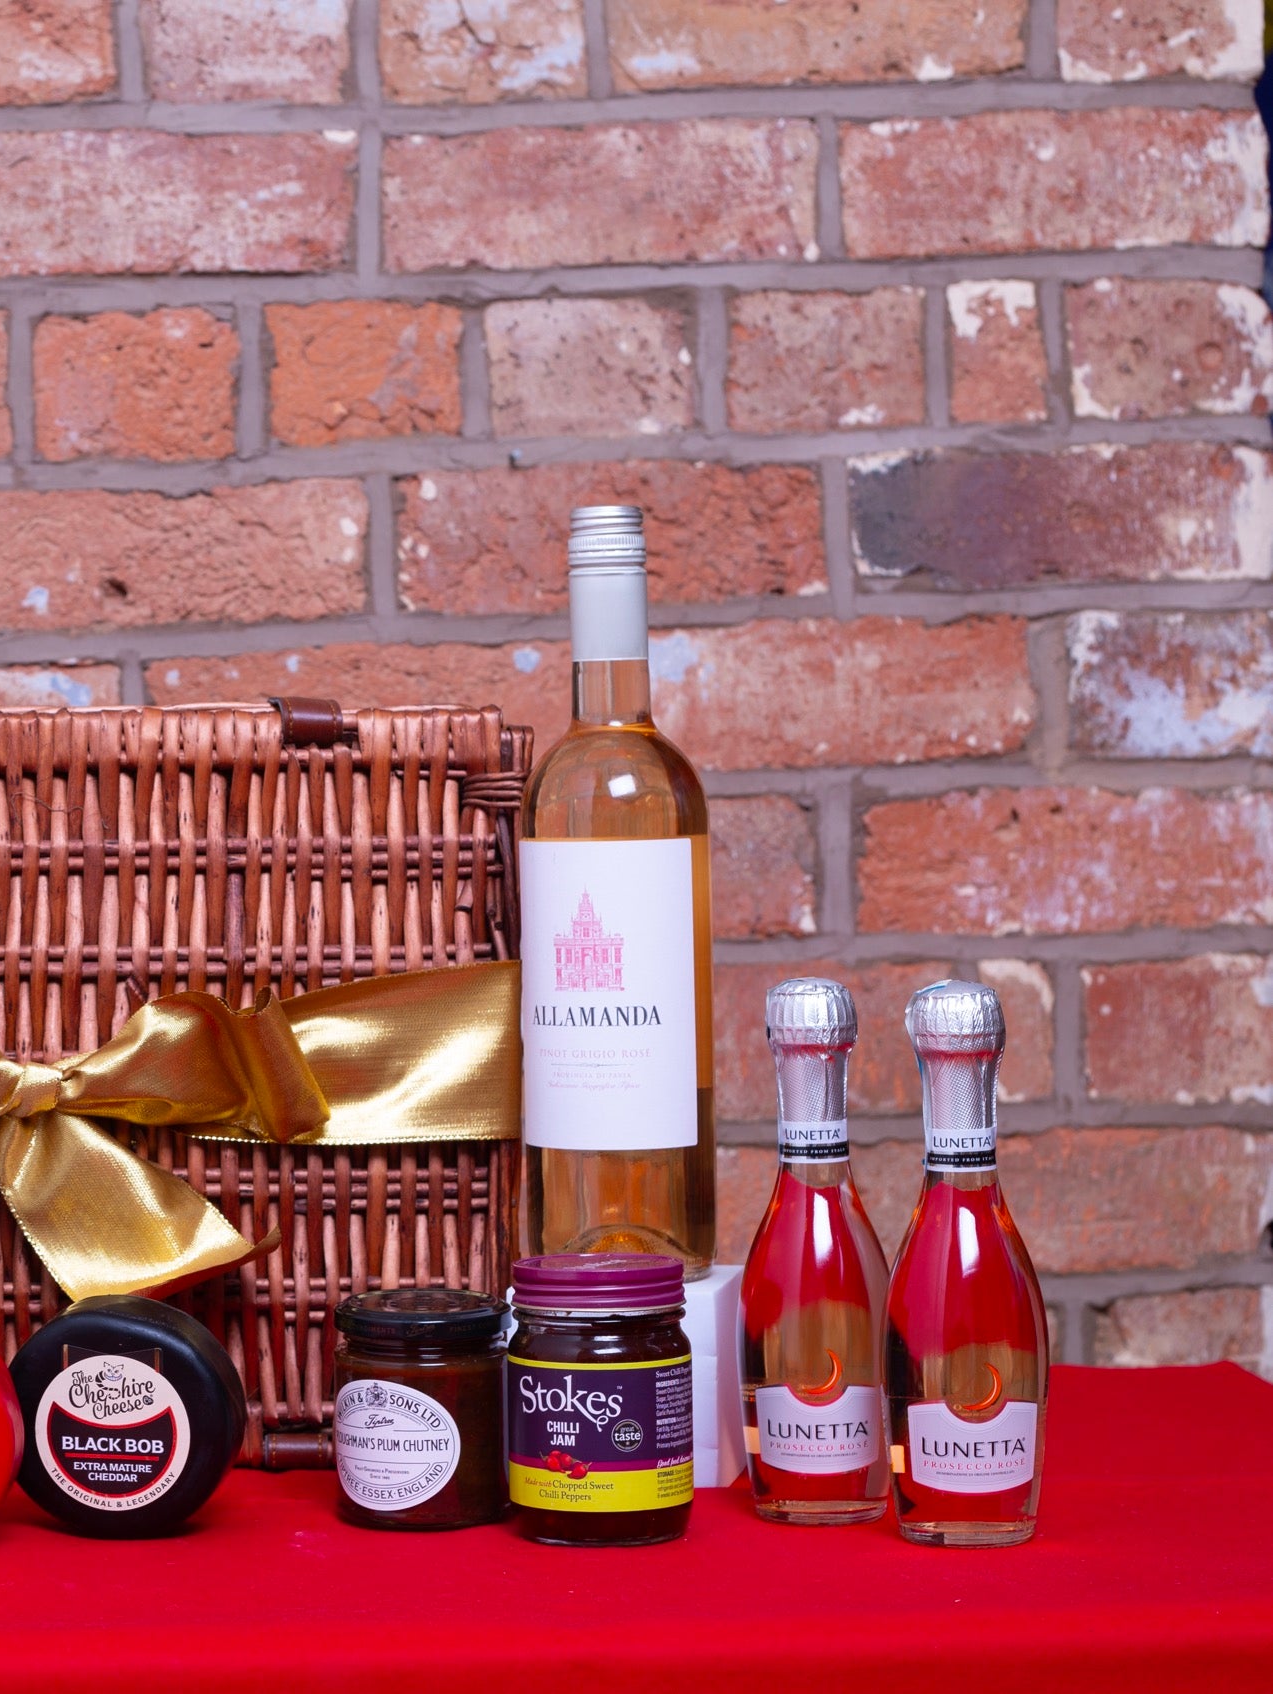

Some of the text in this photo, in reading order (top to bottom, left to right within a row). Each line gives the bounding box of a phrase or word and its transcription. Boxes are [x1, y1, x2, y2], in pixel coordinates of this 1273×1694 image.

[532, 1004, 662, 1027] ALLAMANDA
[571, 1049, 616, 1059] GRIGIO
[785, 1128, 841, 1142] LUNETTA
[933, 1136, 991, 1149] LUNETTA
[71, 1370, 93, 1386] The
[93, 1398, 143, 1420] Cheese
[519, 1374, 623, 1431] Stokes
[357, 1392, 363, 1403] &
[389, 1394, 421, 1414] SONS
[421, 1408, 441, 1428] LTD
[364, 1414, 395, 1429] Tiptree
[547, 1420, 579, 1434] CHILLI
[767, 1418, 867, 1440] LUNETTA
[551, 1434, 575, 1446] JAM
[615, 1432, 641, 1441] taste
[61, 1436, 165, 1454] BLACK BOB
[377, 1440, 401, 1452] PLUM
[403, 1438, 449, 1452] CHUTNEY
[770, 1442, 833, 1452] PROSECCO
[921, 1436, 1025, 1458] LUNETTA
[73, 1462, 153, 1473] EXTRA MATURE
[923, 1460, 992, 1470] PROSECCO
[87, 1472, 138, 1482] CHEDDAR
[397, 1464, 443, 1498] ENGLAND
[51, 1468, 67, 1486] THE
[67, 1485, 112, 1508] ORIGINAL
[126, 1472, 175, 1507] LEGENDARY
[553, 1480, 587, 1492] Chopped
[589, 1481, 614, 1490] Sweet
[539, 1488, 591, 1502] Chilli Peppers
